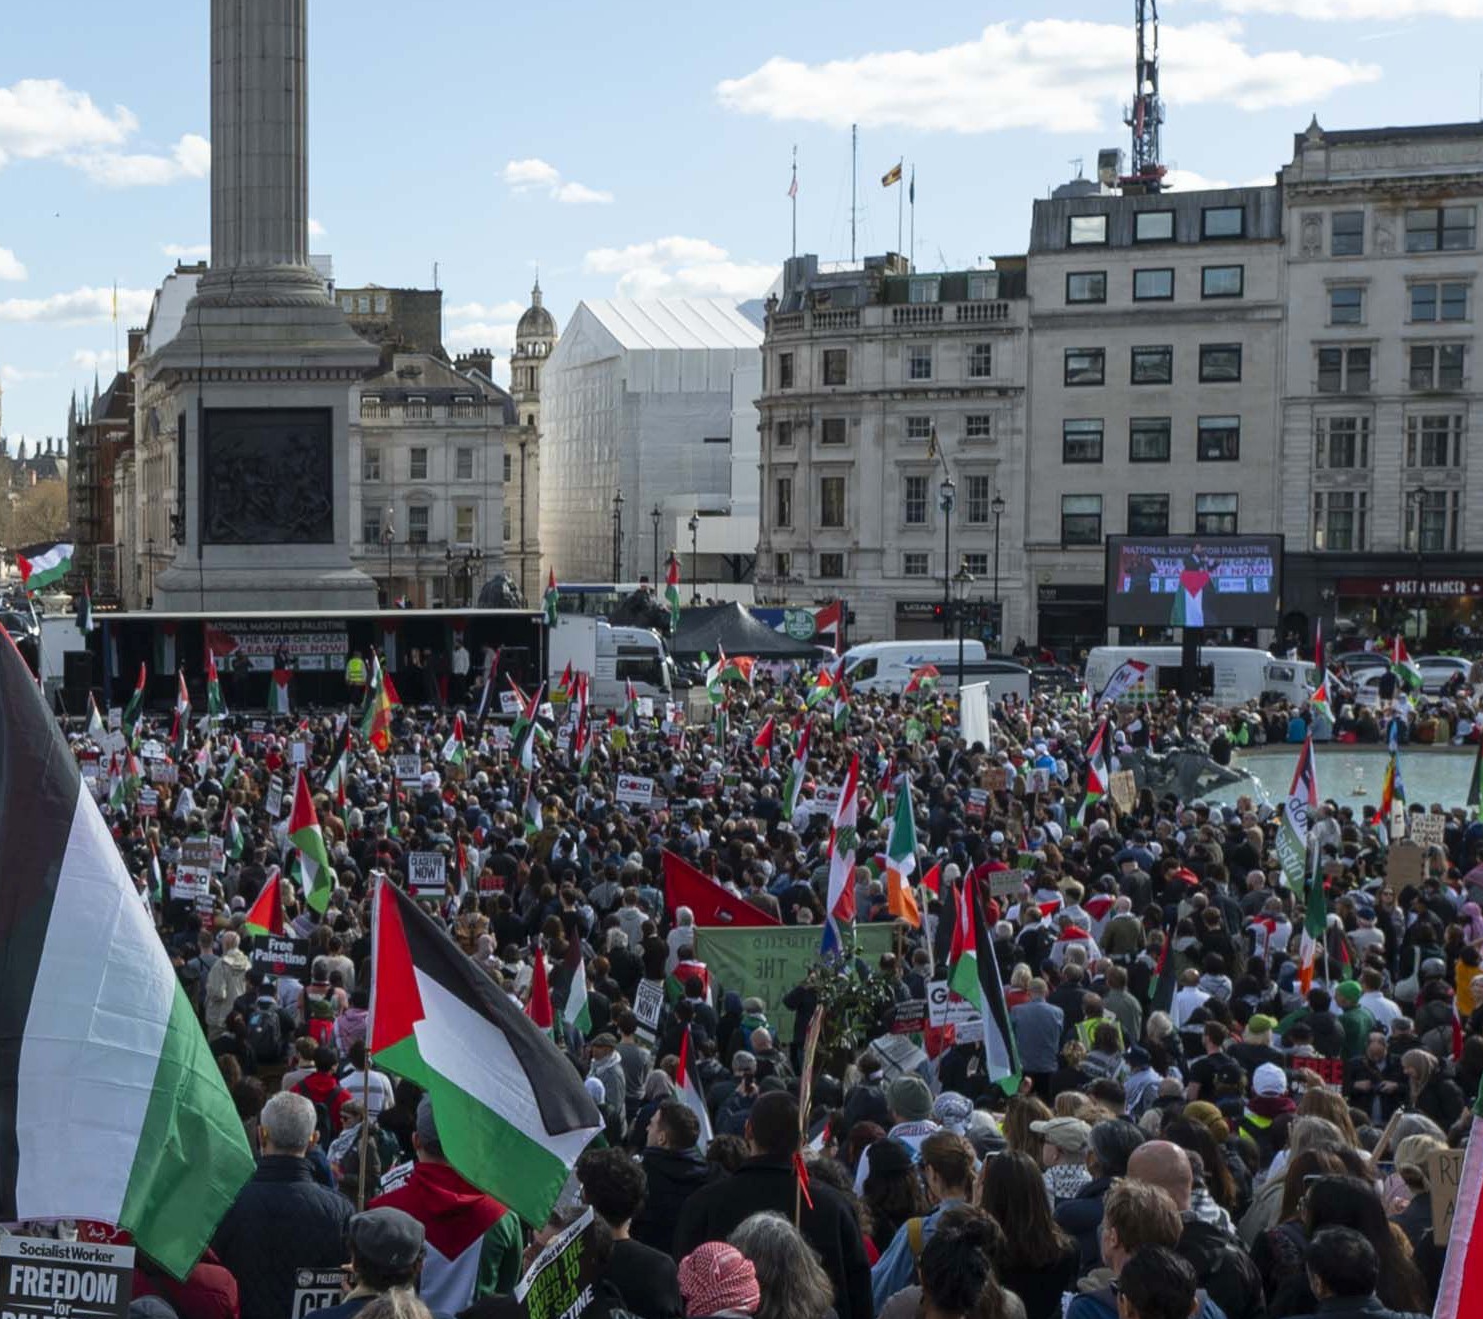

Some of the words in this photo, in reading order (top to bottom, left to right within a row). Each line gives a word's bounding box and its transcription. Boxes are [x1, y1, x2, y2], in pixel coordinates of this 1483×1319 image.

[1396, 581, 1418, 594] PRET
[1420, 581, 1426, 594] A
[619, 778, 651, 792] Gza
[176, 870, 209, 885] Gza
[268, 938, 294, 952] Free
[254, 948, 307, 965] Palestine
[562, 1234, 586, 1268] THE
[564, 1260, 580, 1286] TO
[8, 1264, 118, 1304] FREEDOM
[50, 1299, 72, 1316] for
